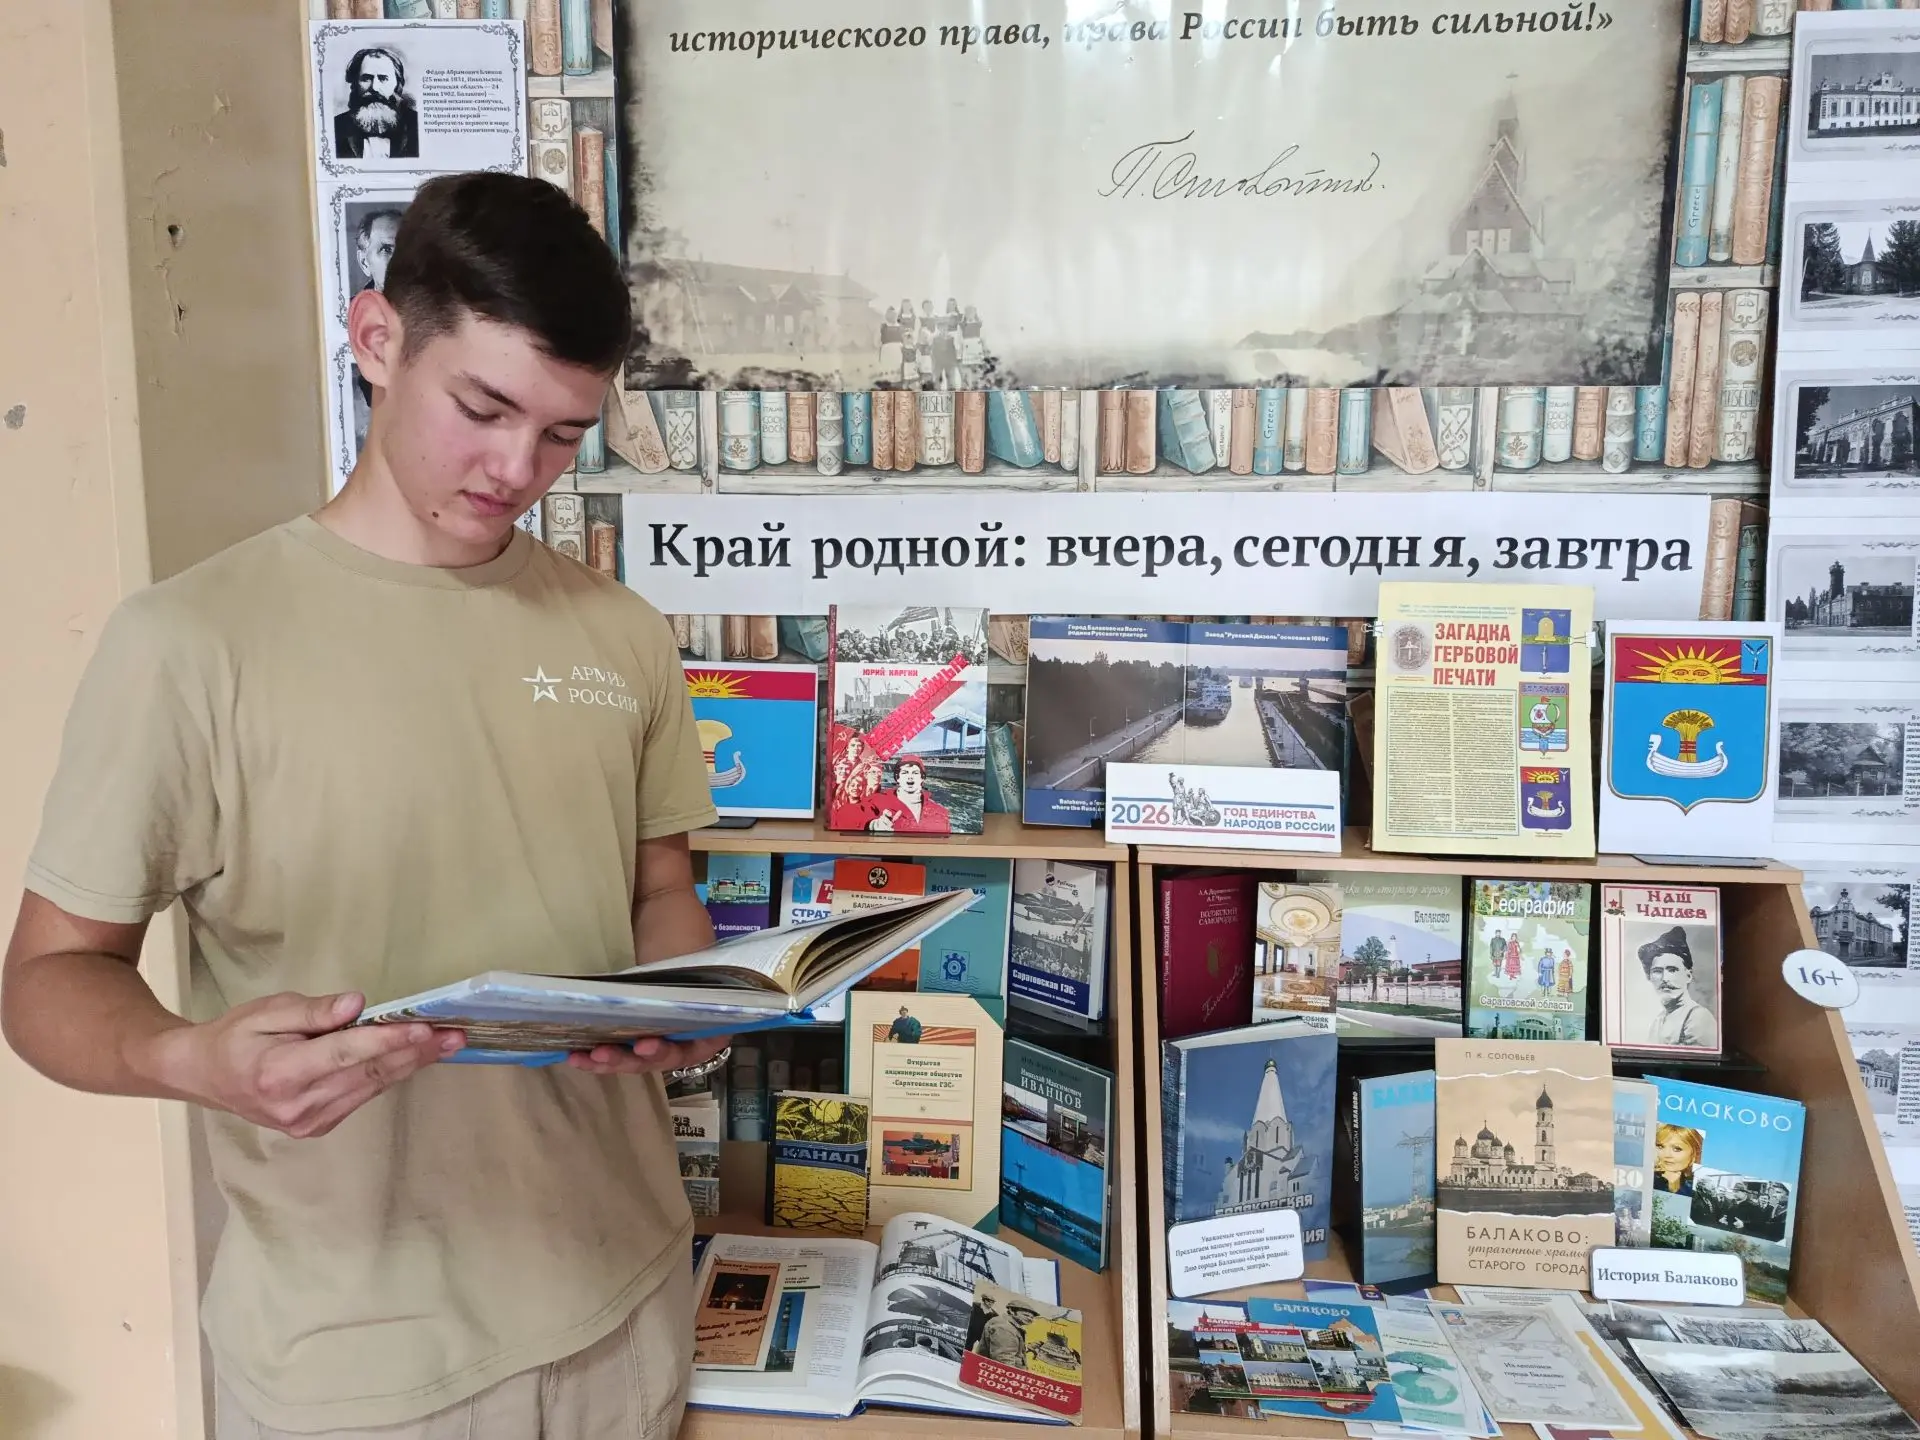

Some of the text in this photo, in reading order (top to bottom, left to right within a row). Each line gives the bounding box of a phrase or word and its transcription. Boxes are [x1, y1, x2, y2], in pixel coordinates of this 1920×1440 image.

[668, 2, 1614, 58] исторического права, права России быть сильной!»
[648, 522, 1693, 582] Край родной: вчера, сегодня, завтра
[1435, 623, 1511, 643] ЗАГАДКА
[1434, 645, 1518, 665] ГЕРБОВОЙ
[1433, 668, 1496, 687] ПЕЧАТИ
[568, 687, 638, 713] РОССИИ
[1111, 803, 1170, 825] 2026
[1223, 807, 1317, 820] ГОД ЕДИНСТВА
[1223, 818, 1336, 832] НАРОДОВ РОССИИ
[1491, 890, 1575, 920] География
[1647, 890, 1692, 904] НАШ
[1635, 904, 1708, 919] ЧАПАЕВ
[1012, 968, 1059, 991] Саратовская
[1060, 983, 1077, 996] ГЭС:
[1797, 965, 1844, 986] 16+
[1480, 995, 1574, 1011] Саратовской области
[1487, 1052, 1536, 1062] СОЛОВЬЕВ
[1021, 1076, 1082, 1109] ИВАНЦОВ
[782, 1147, 859, 1165] КАНАЛ
[1466, 1226, 1590, 1245] БАЛАКОВО:
[1467, 1243, 1542, 1258] утраченные
[1468, 1259, 1588, 1276] СТАРОГО ГОРОДА
[1598, 1267, 1739, 1287] История Балаково
[976, 1376, 1036, 1401] ГОРДАЯ
[977, 1369, 1069, 1402] ПРОФЕССИЯ
